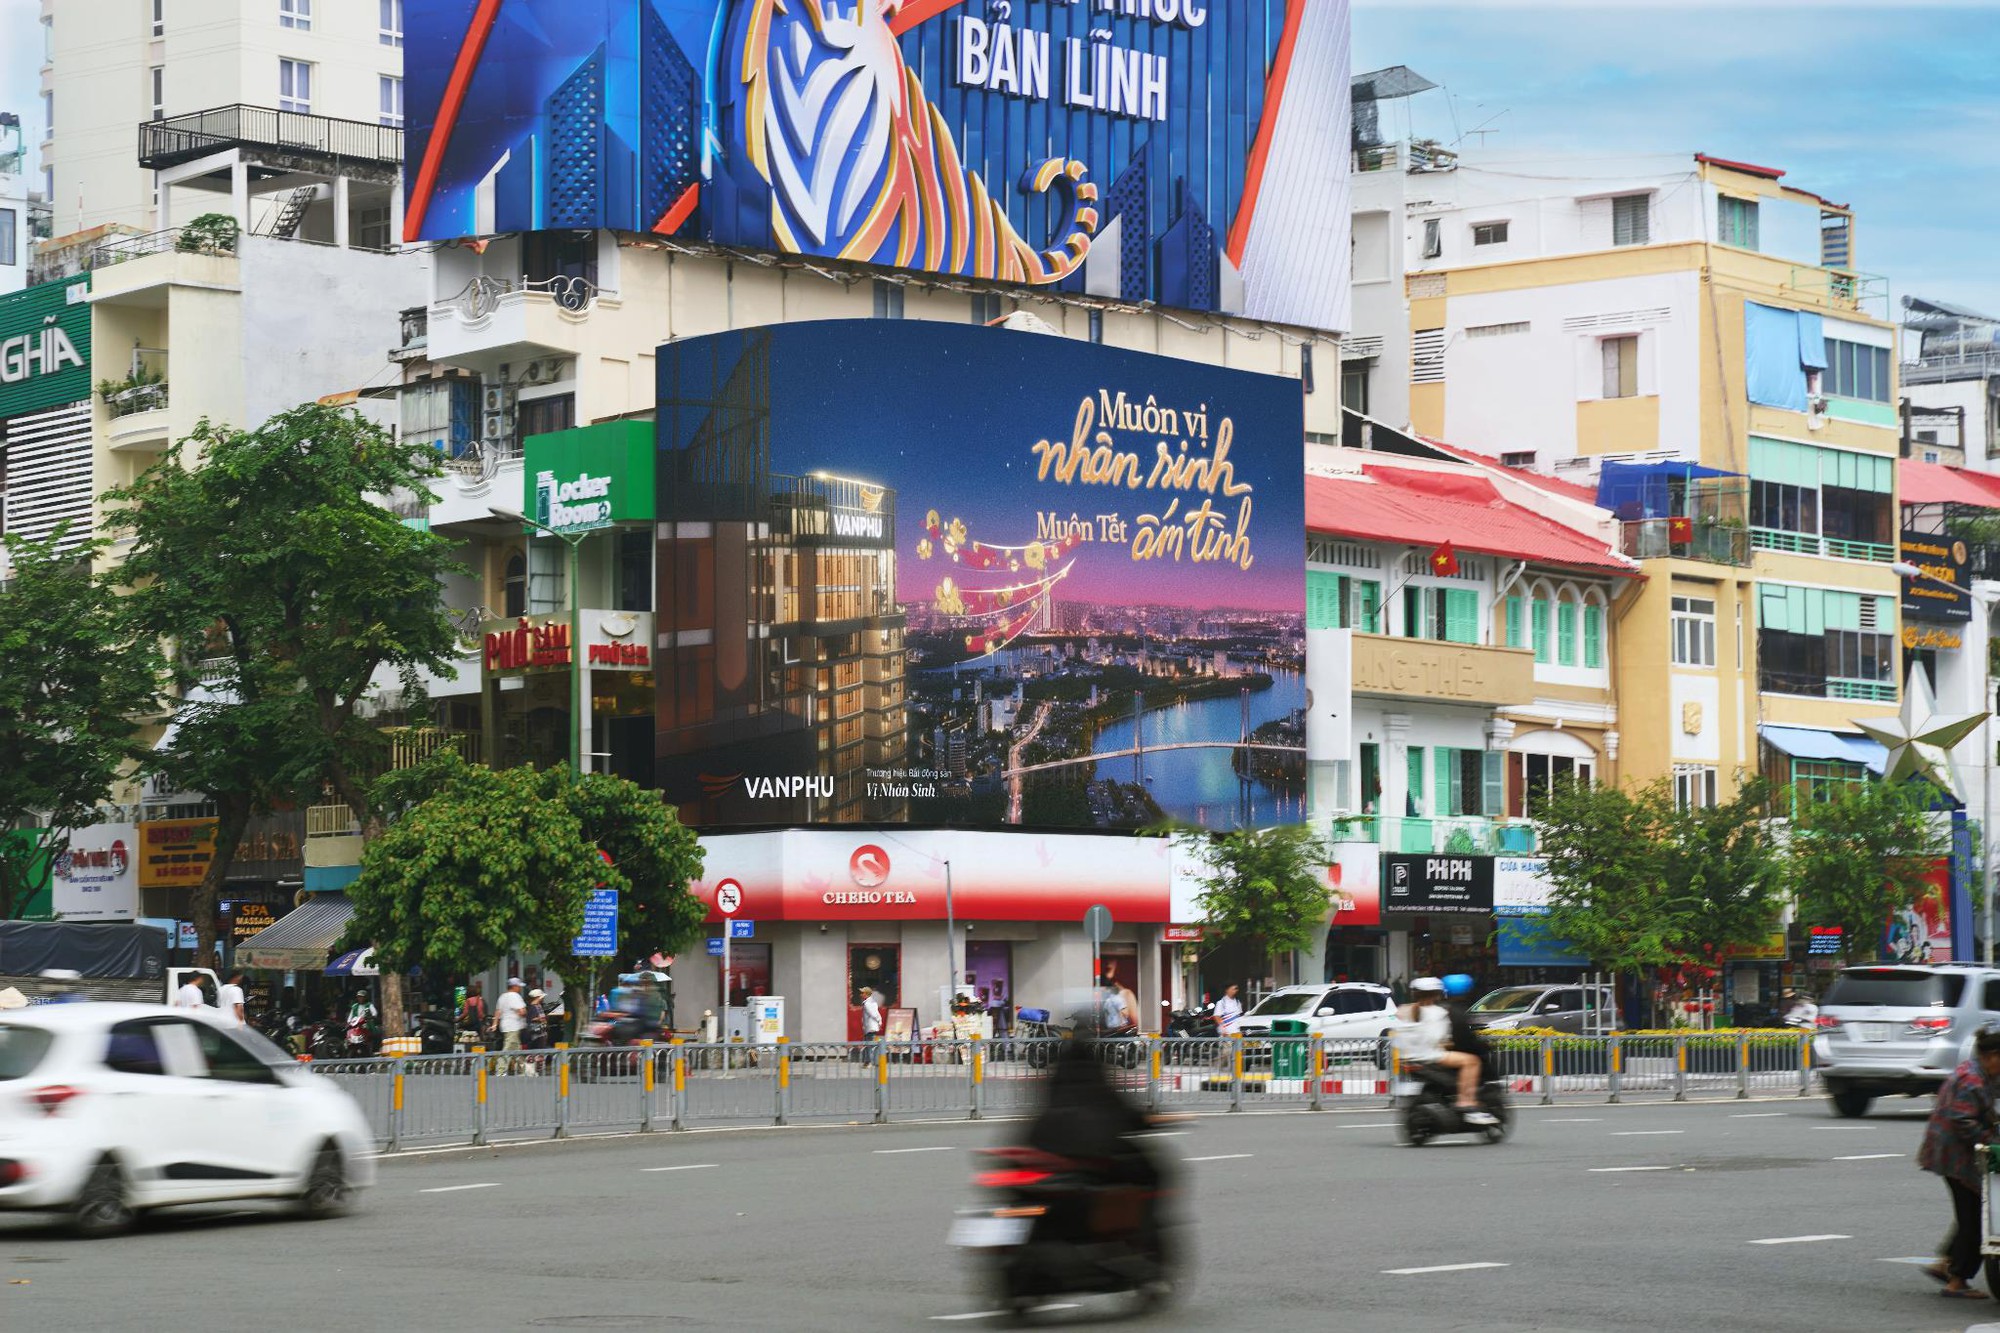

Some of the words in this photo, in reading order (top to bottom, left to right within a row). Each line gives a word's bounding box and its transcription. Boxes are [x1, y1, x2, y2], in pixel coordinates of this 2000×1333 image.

[957, 1, 1050, 99] BẢN
[1065, 28, 1167, 121] LĨNH
[0, 314, 85, 383] GHĨA
[1099, 389, 1179, 436] Muôn
[1182, 403, 1208, 448] vị
[1032, 396, 1143, 489] nhân
[1146, 417, 1253, 496] sinh
[549, 473, 611, 504] Locker
[549, 502, 600, 528] Room
[834, 514, 883, 538] VANPHU
[1036, 511, 1093, 541] Muôn
[1096, 513, 1128, 543] Tết
[1132, 497, 1184, 561] ấm
[1184, 495, 1254, 570] tình
[745, 776, 835, 799] VANPHU
[866, 782, 878, 800] Vị
[880, 782, 909, 798] Nhân
[911, 782, 936, 798] Sinh
[241, 904, 269, 916] SPA
[822, 891, 881, 904] CHEHO
[883, 891, 917, 904] TEA
